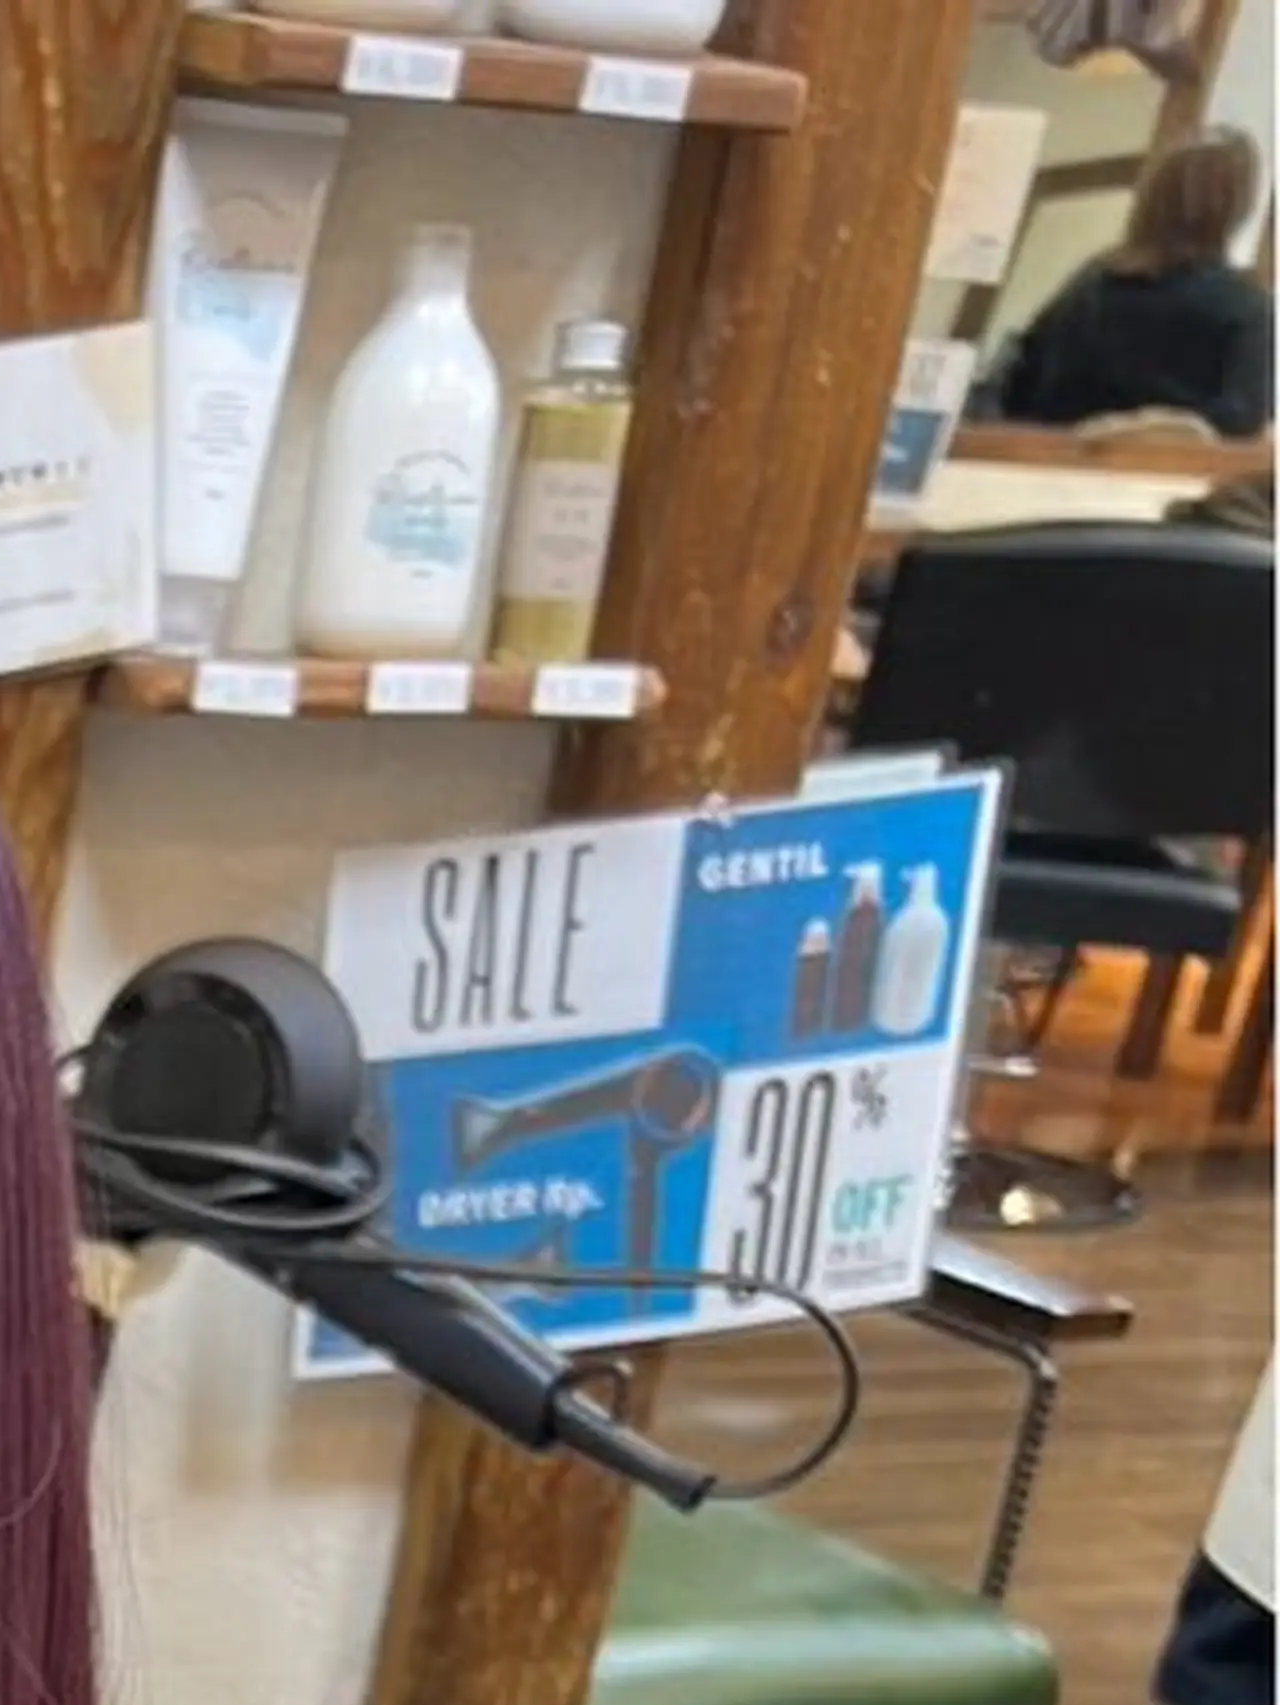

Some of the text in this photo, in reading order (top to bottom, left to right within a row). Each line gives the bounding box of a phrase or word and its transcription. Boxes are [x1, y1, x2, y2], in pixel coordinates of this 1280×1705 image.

[697, 843, 829, 893] GENTIL
[413, 844, 594, 1031] SALE
[420, 1182, 536, 1228] DRYER
[830, 1173, 914, 1233] OFF
